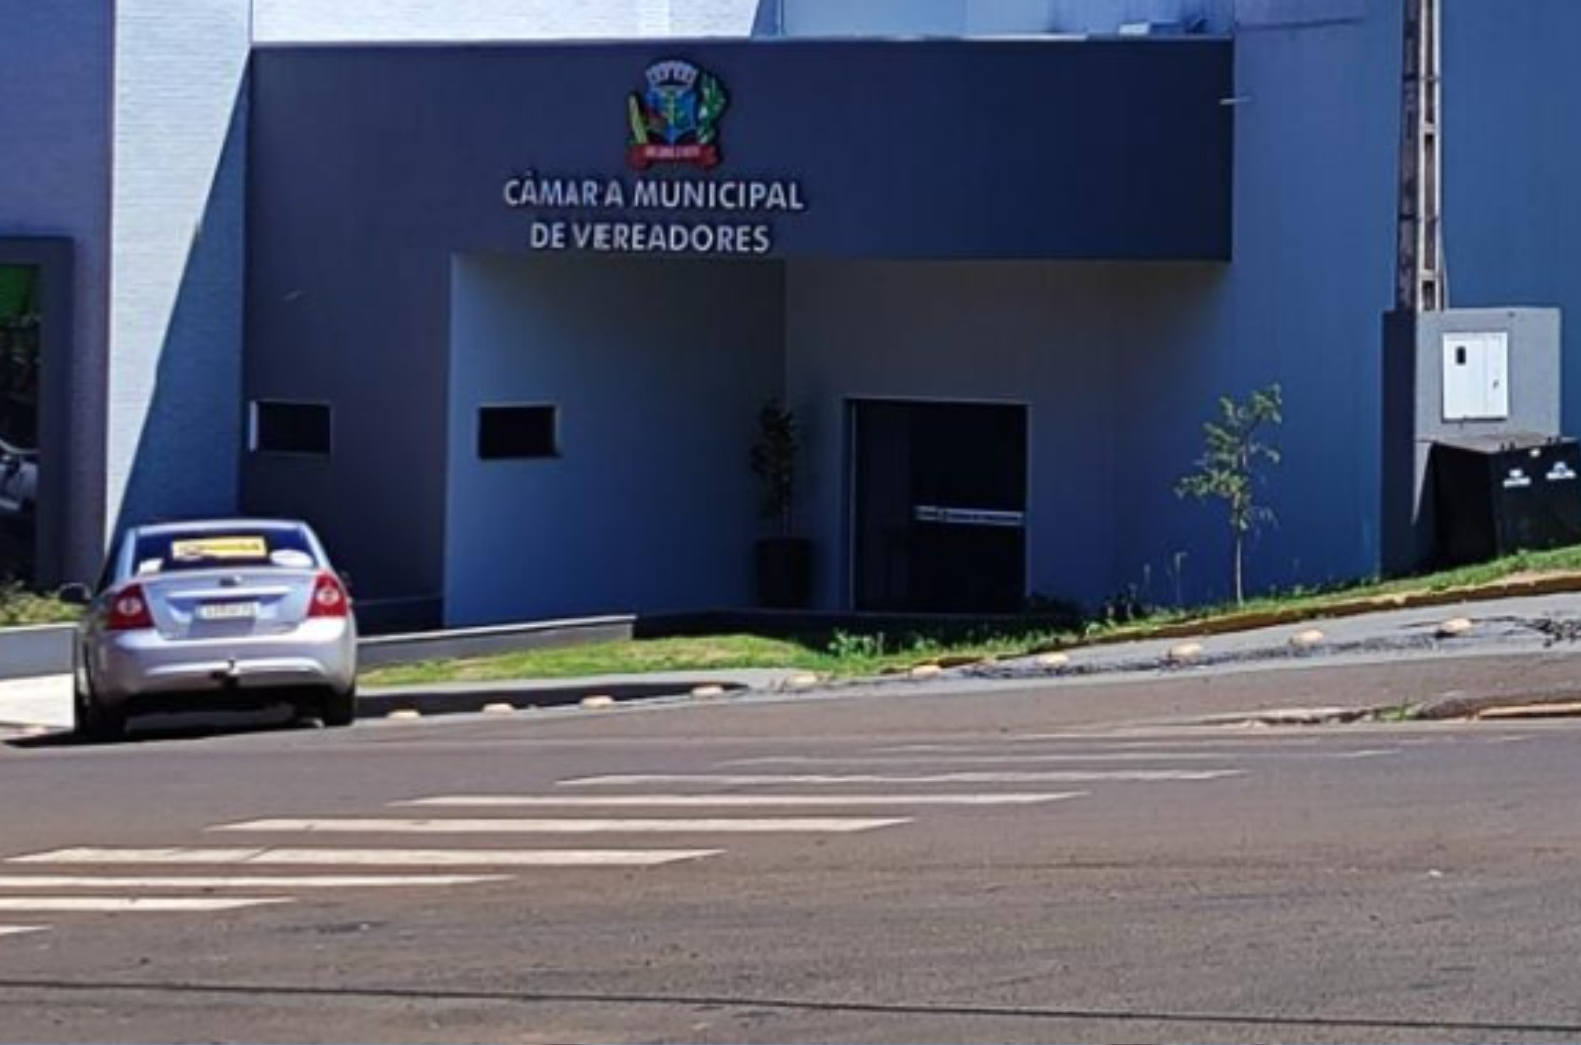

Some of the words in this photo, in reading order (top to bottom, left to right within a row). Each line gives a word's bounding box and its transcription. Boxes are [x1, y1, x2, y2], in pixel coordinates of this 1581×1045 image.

[503, 170, 624, 208] CÂMARA
[633, 180, 804, 210] MUNICIPAL
[530, 222, 566, 249] DE
[573, 223, 770, 253] VEREADORES
